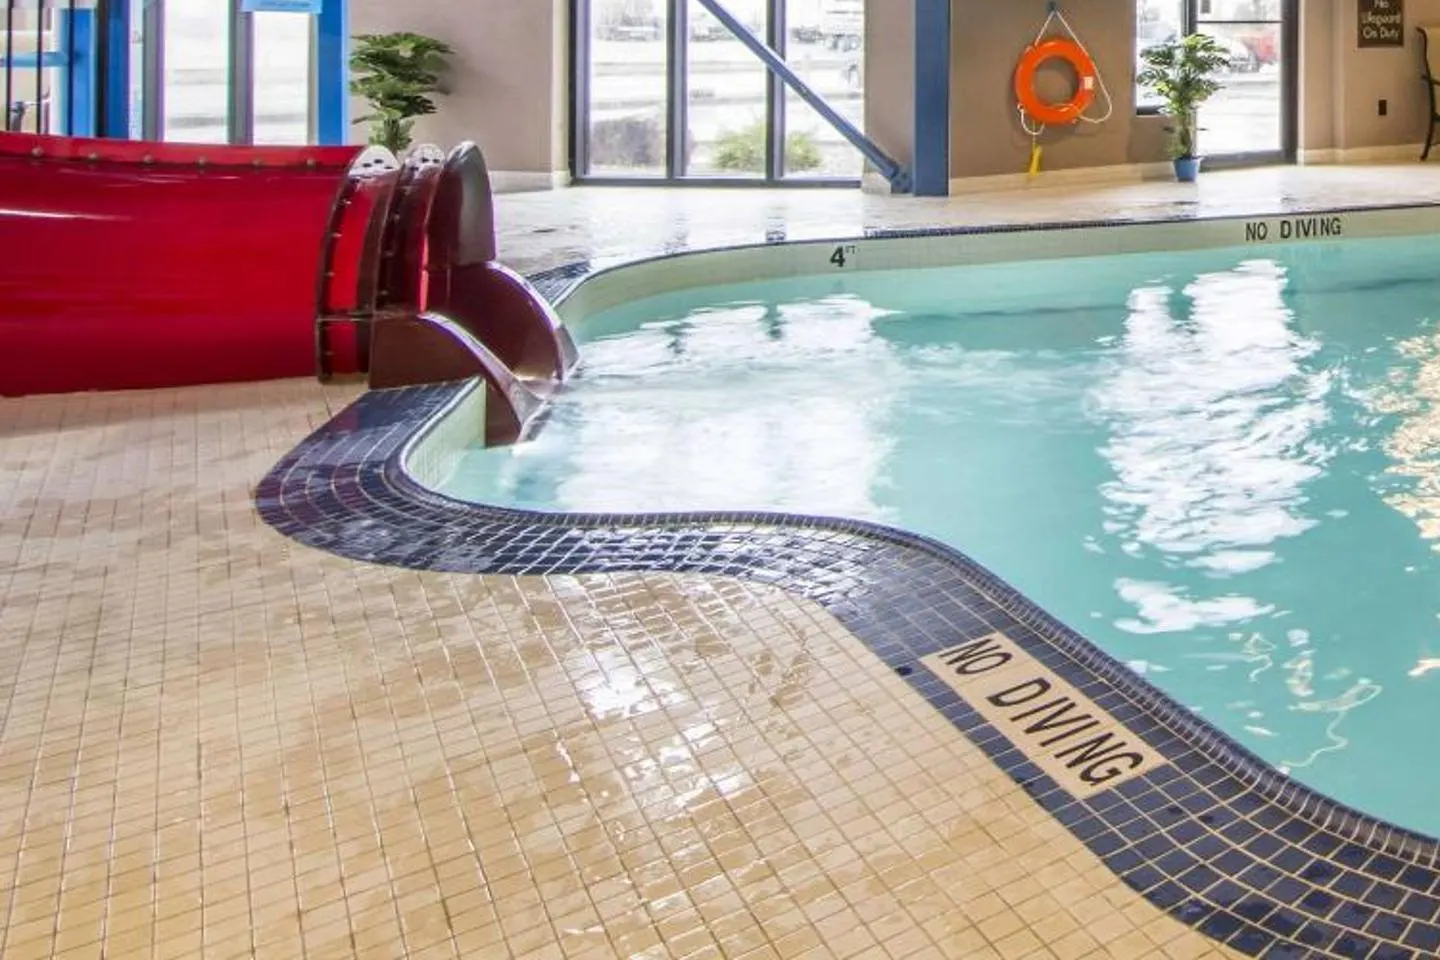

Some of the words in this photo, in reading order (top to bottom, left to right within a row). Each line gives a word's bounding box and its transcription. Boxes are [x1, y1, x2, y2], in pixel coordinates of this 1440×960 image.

[1245, 222, 1268, 241] NO
[1280, 217, 1341, 239] DIVING
[938, 639, 1013, 675] NO
[985, 677, 1144, 788] DIVING
